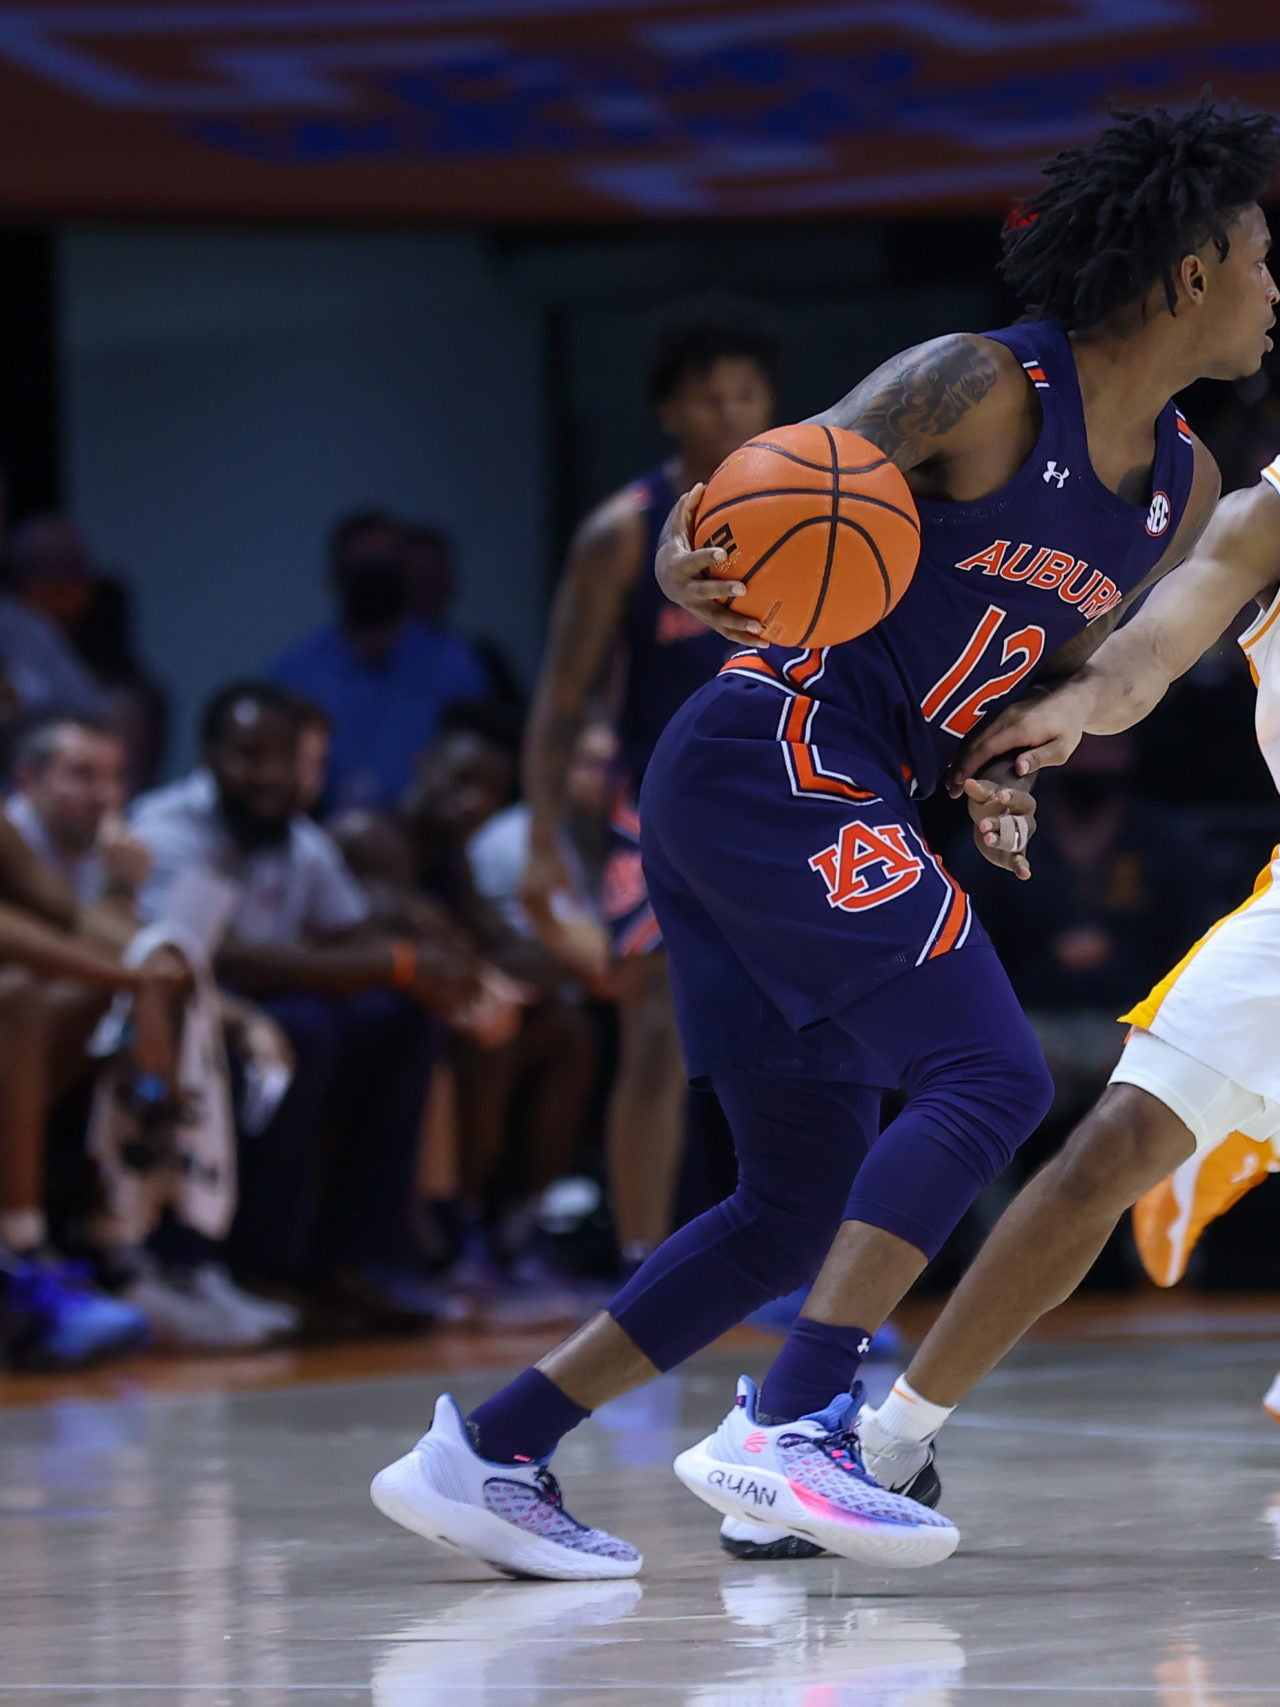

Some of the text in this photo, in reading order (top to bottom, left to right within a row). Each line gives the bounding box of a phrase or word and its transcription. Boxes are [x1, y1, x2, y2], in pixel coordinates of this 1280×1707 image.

[1146, 494, 1168, 533] SEC
[920, 604, 1045, 739] 12
[707, 1470, 778, 1507] QUAN
